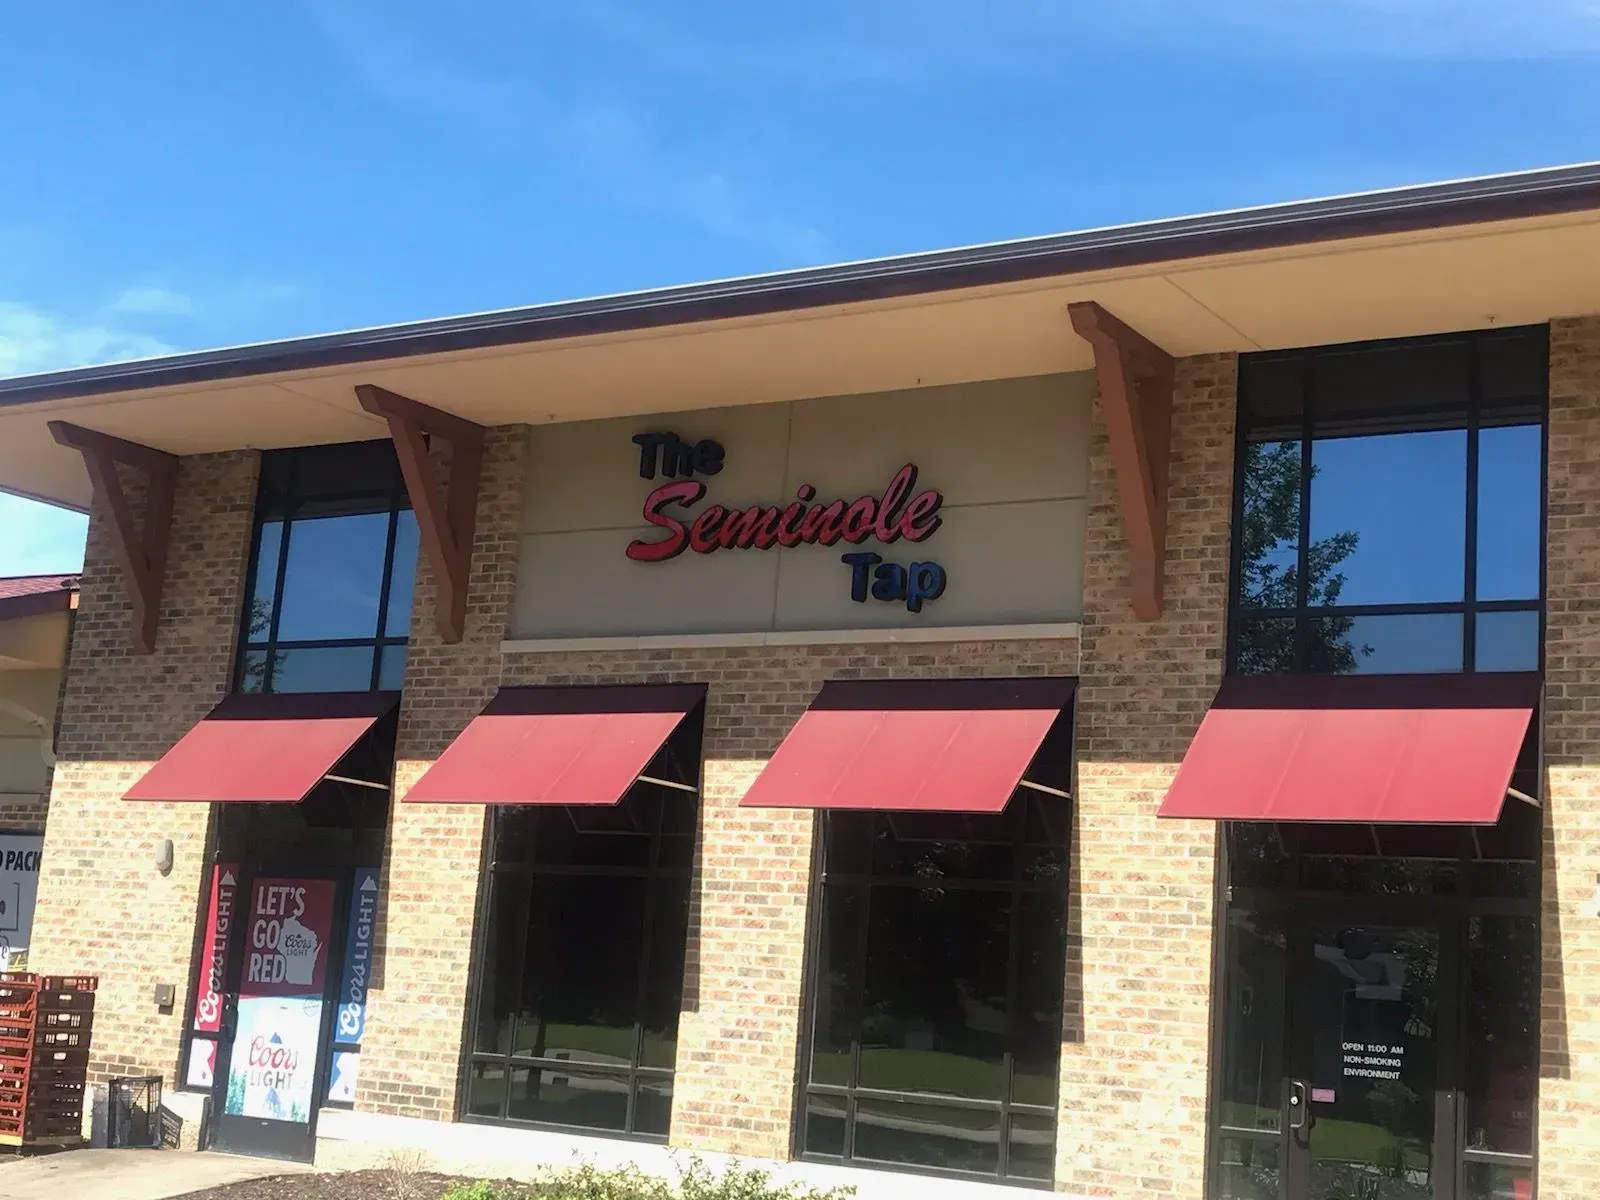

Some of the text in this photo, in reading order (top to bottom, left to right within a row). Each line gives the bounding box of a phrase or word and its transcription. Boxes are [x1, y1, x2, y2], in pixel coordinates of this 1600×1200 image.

[632, 432, 725, 479] The
[626, 463, 943, 561] Seminole
[841, 551, 946, 613] Tap
[256, 885, 306, 917] LET'S
[252, 918, 281, 950] GO
[285, 934, 312, 949] Coors
[199, 889, 232, 1023] Coors LIGHT
[248, 952, 286, 984] RED
[286, 948, 308, 957] LIGHT
[339, 895, 374, 1036] Coors LIGHT
[1342, 1042, 1404, 1054] OPEN 11:00 AM
[1344, 1055, 1401, 1067] NON-SMOKING
[249, 1070, 293, 1090] LIGHT
[1344, 1067, 1400, 1080] ENVIRONMENT
